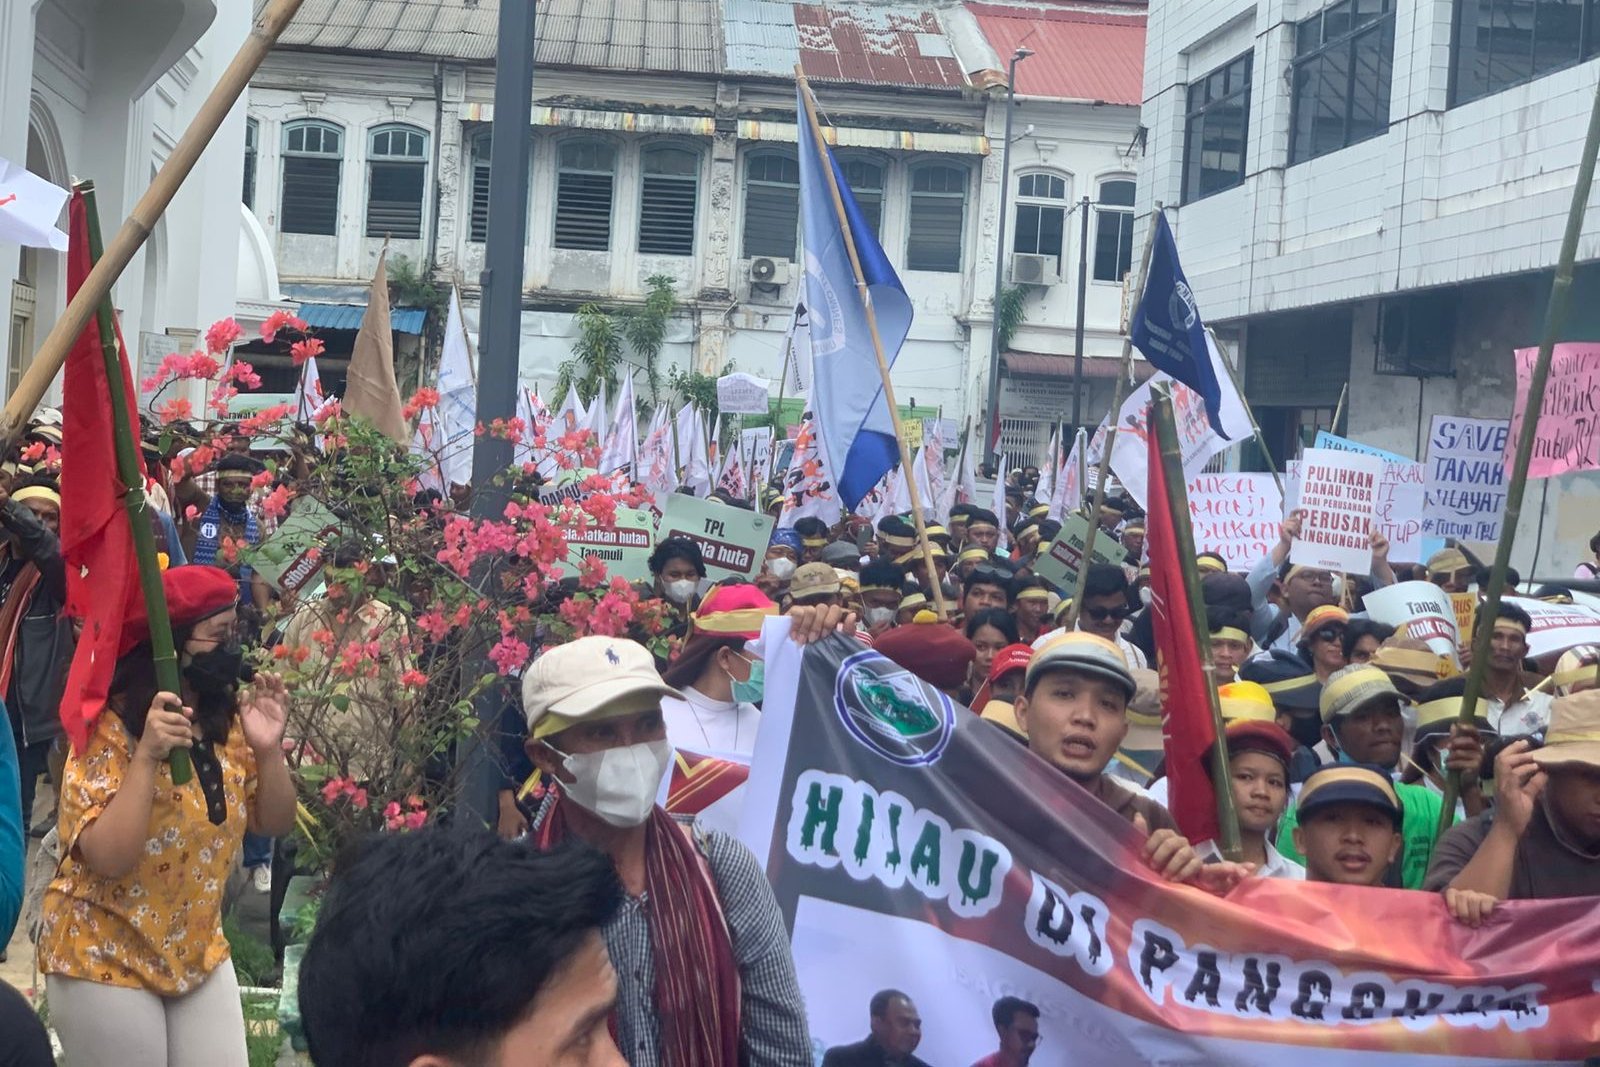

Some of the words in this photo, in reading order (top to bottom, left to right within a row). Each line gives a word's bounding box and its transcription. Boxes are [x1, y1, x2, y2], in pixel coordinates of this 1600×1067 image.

[1433, 422, 1508, 452] SAVE
[1307, 465, 1374, 489] PULIHKAN
[1434, 455, 1504, 486] TANAH
[541, 482, 581, 506] DANAU
[1304, 481, 1342, 498] DANAU
[1346, 486, 1372, 503] TOBA
[1302, 496, 1321, 507] DARI
[1323, 499, 1372, 514] PERUSAHAAN
[703, 518, 726, 538] TPL
[1300, 508, 1371, 536] PERUSAK
[1374, 519, 1420, 545] UTUP
[619, 530, 648, 545] hutan
[1297, 528, 1369, 550] LINGKUNGAN
[717, 545, 750, 567] huta
[1407, 601, 1442, 615] Tanah
[1452, 598, 1472, 615] RUS
[801, 782, 999, 906] HIJAU
[1035, 883, 1104, 964] DI
